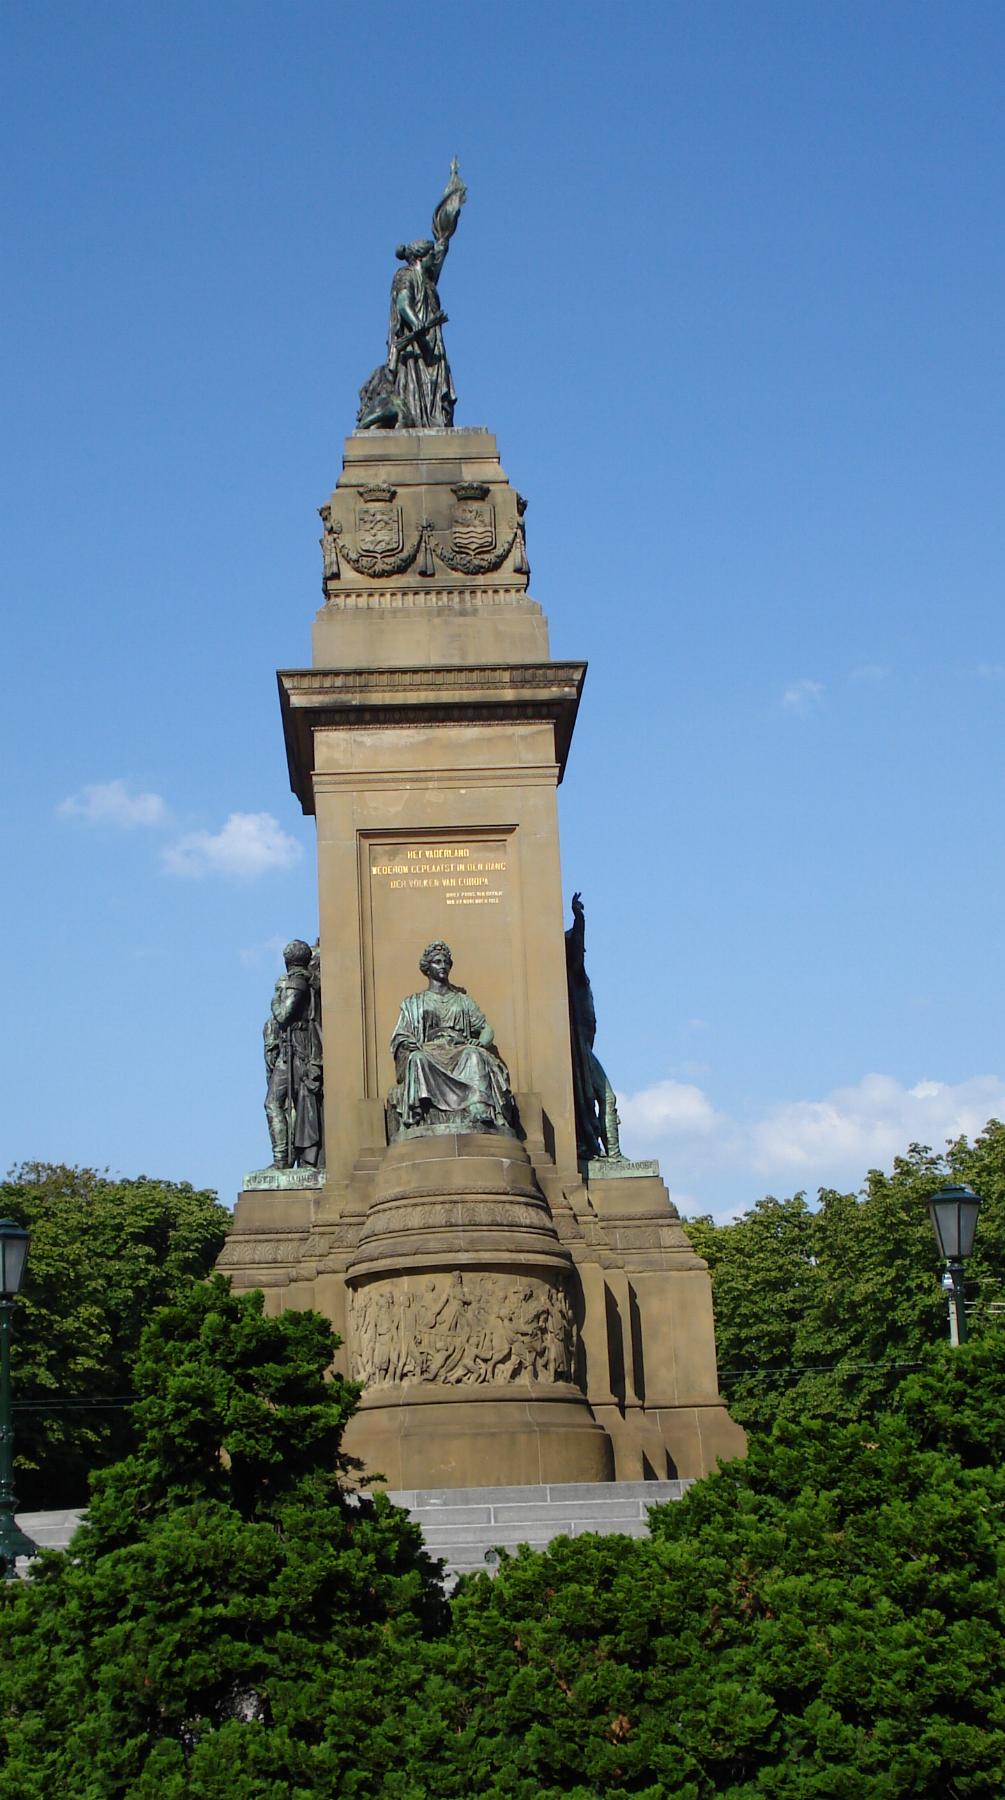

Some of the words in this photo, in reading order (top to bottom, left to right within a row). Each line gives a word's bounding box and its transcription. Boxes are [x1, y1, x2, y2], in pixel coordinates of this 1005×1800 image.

[407, 850, 421, 859] HET
[425, 848, 470, 859] VADERLAND
[456, 862, 465, 872] IN
[467, 862, 483, 871] DEN
[390, 880, 406, 889] DER
[409, 879, 439, 888] VOLKEN
[442, 878, 456, 887] VAN
[458, 877, 489, 887] EUROPA
